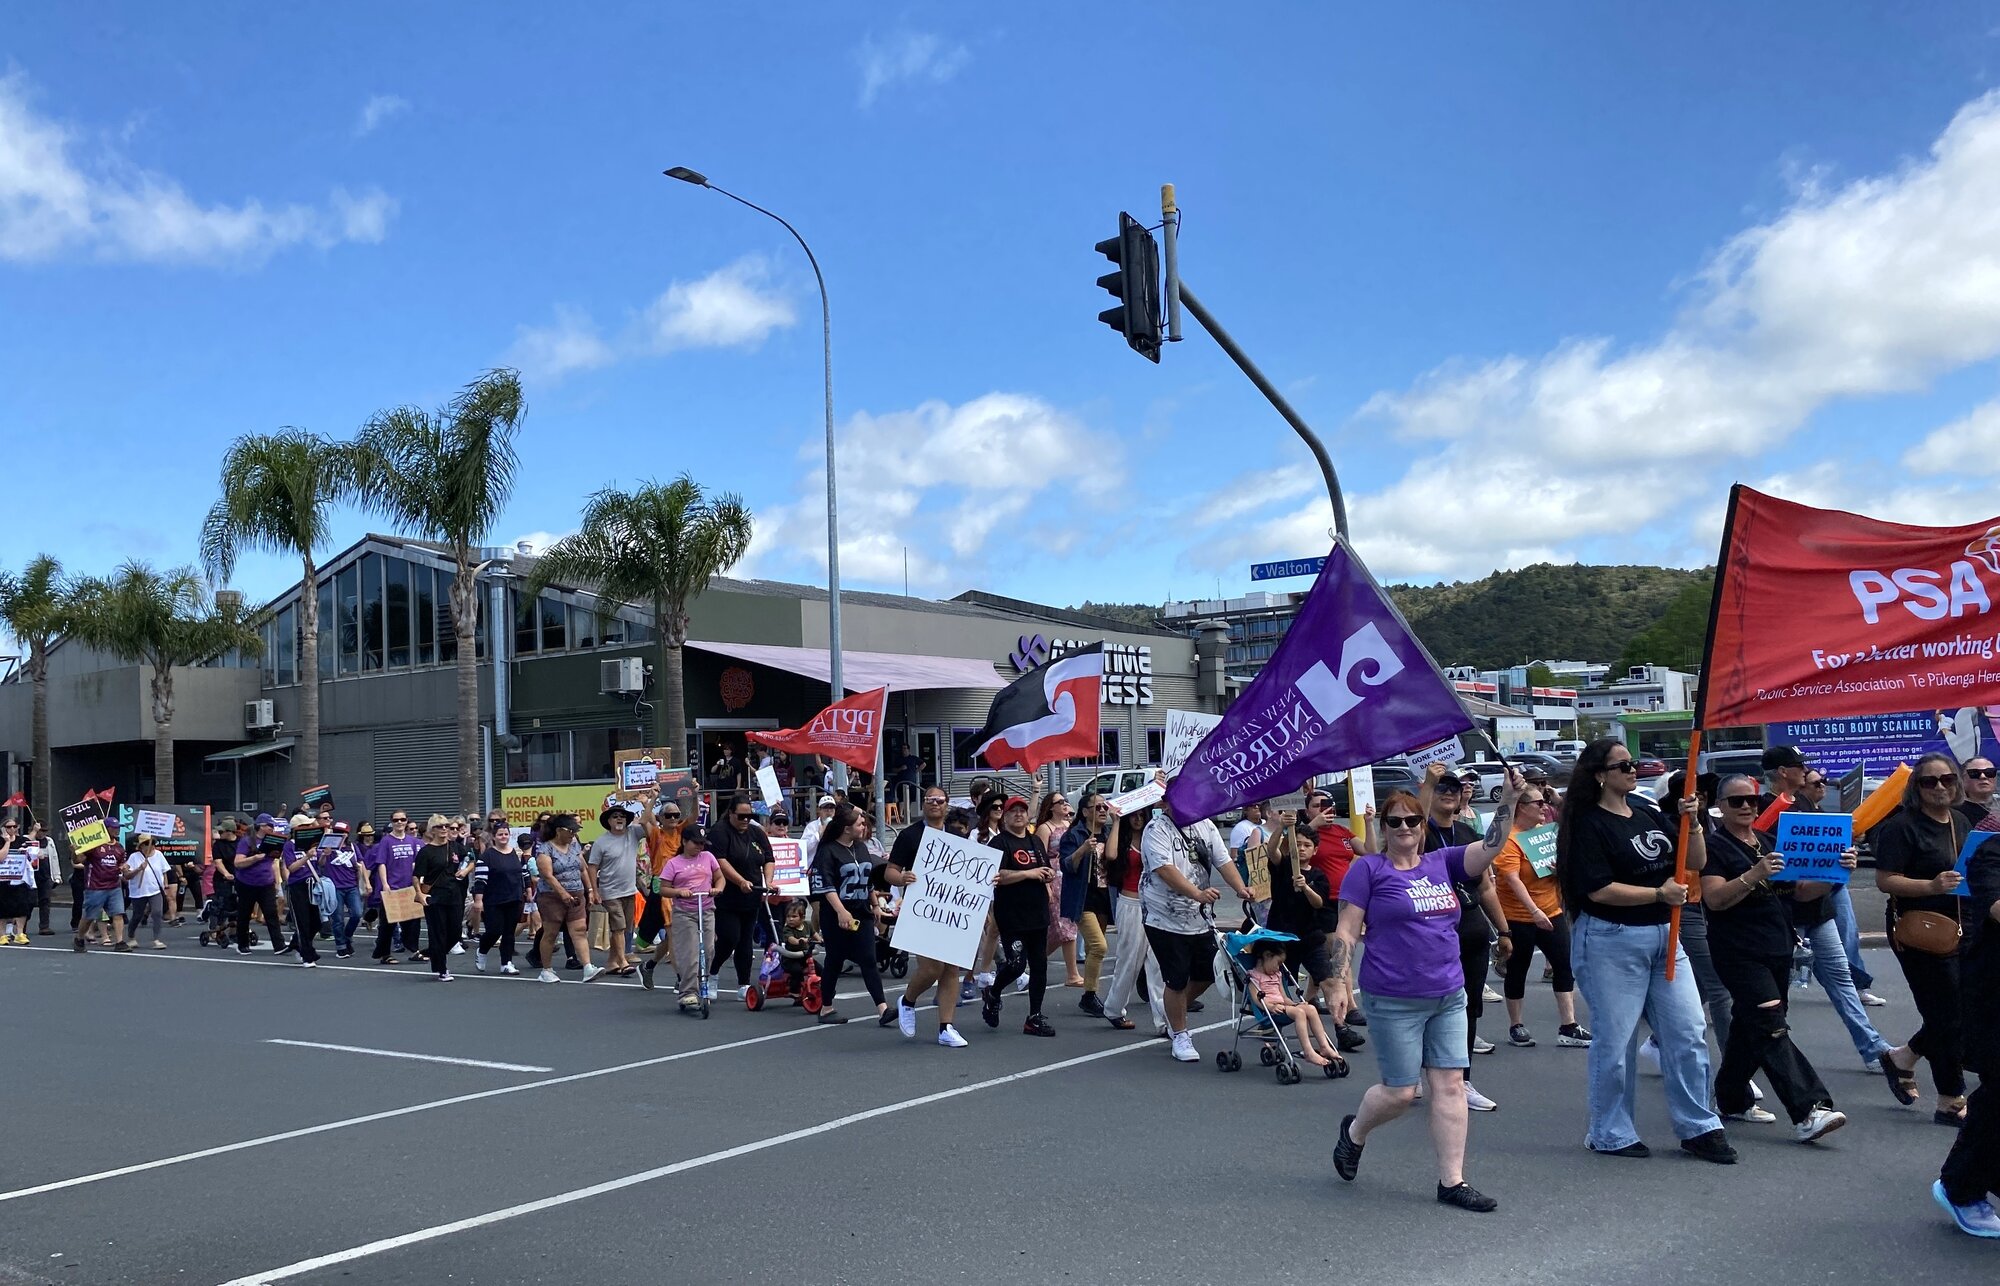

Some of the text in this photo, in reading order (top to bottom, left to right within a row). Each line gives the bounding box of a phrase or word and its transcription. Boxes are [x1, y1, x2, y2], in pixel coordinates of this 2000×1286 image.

[1265, 558, 1326, 577] Walton S
[1848, 560, 1991, 625] PSA
[1811, 649, 1851, 669] For
[1921, 634, 1993, 660] working
[1790, 682, 1833, 697] Service
[1834, 677, 1905, 693] Association
[1908, 673, 1926, 688] Te
[1927, 671, 1975, 688] Pūkenga
[1787, 719, 1932, 736] EVOLT 360 BODY SCANNER
[1411, 742, 1456, 764] GONE CRAZY
[66, 802, 91, 816] STILL
[506, 795, 554, 808] KOREAN
[507, 810, 540, 823] FRIED
[1790, 825, 1843, 837] CARE FOR
[773, 850, 796, 859] PUBLIC
[1783, 841, 1846, 853] US TO CARE
[1246, 842, 1269, 871] TA
[1786, 857, 1836, 868] FOR YOU
[1250, 868, 1269, 885] RIC
[1409, 875, 1432, 887] NOT
[924, 874, 991, 912] YEAH RIGHT
[1405, 881, 1452, 898] ENOUGH
[1413, 895, 1456, 912] NURSES
[912, 898, 972, 931] COLLINS
